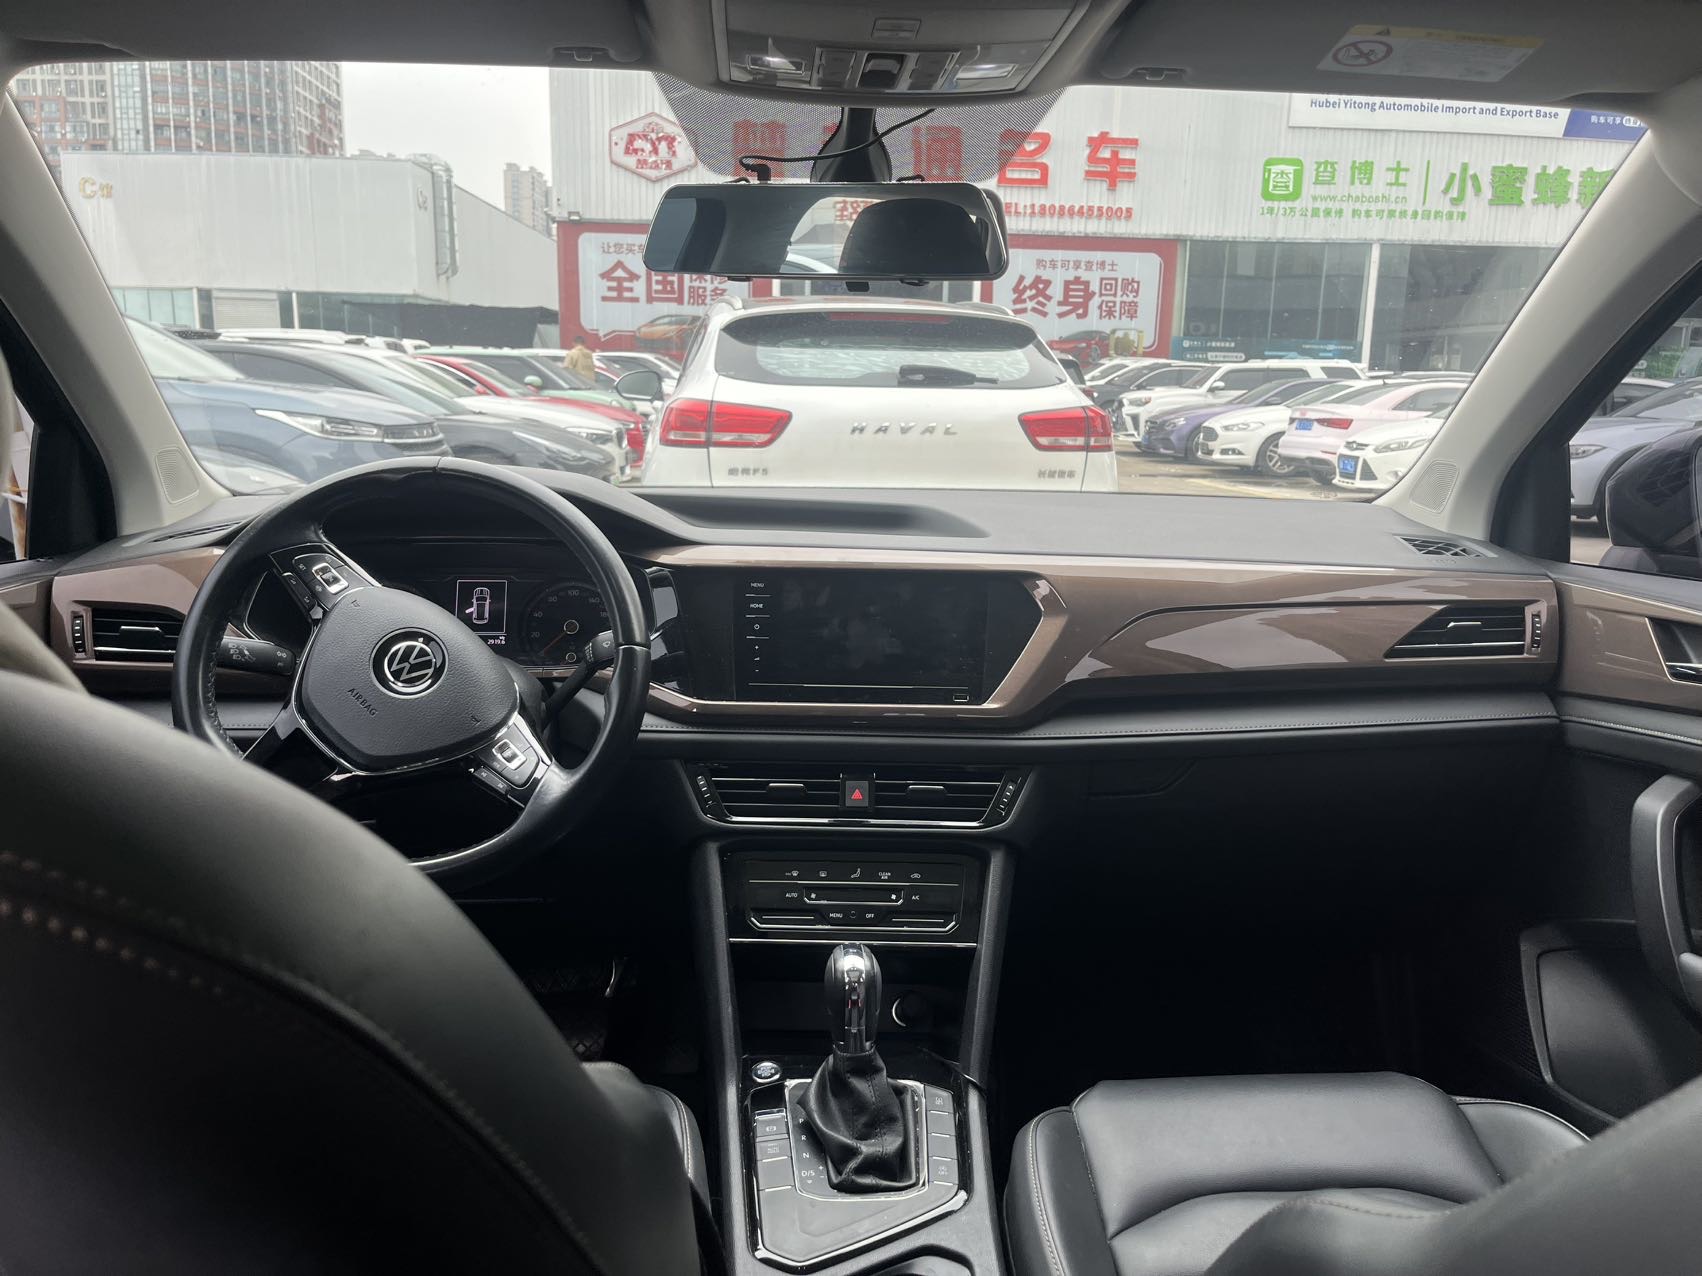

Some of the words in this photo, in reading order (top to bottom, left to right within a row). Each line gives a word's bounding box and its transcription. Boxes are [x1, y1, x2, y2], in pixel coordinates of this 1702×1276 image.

[1310, 98, 1341, 109] Hubei
[1343, 99, 1377, 112] Yitong
[1378, 101, 1439, 113] Automobile
[1441, 104, 1476, 115] Import
[1479, 106, 1498, 116] and
[1500, 107, 1533, 119] Export
[1535, 109, 1559, 119] Base
[1312, 159, 1411, 187] 查博士
[1003, 201, 1134, 221] EL:18086455005
[598, 259, 685, 305] 全国
[1098, 276, 1141, 299] 回购
[1011, 273, 1097, 320] 终身
[1097, 299, 1140, 321] 保障
[850, 421, 959, 436] HAVAL
[347, 688, 378, 717] AIRBAG
